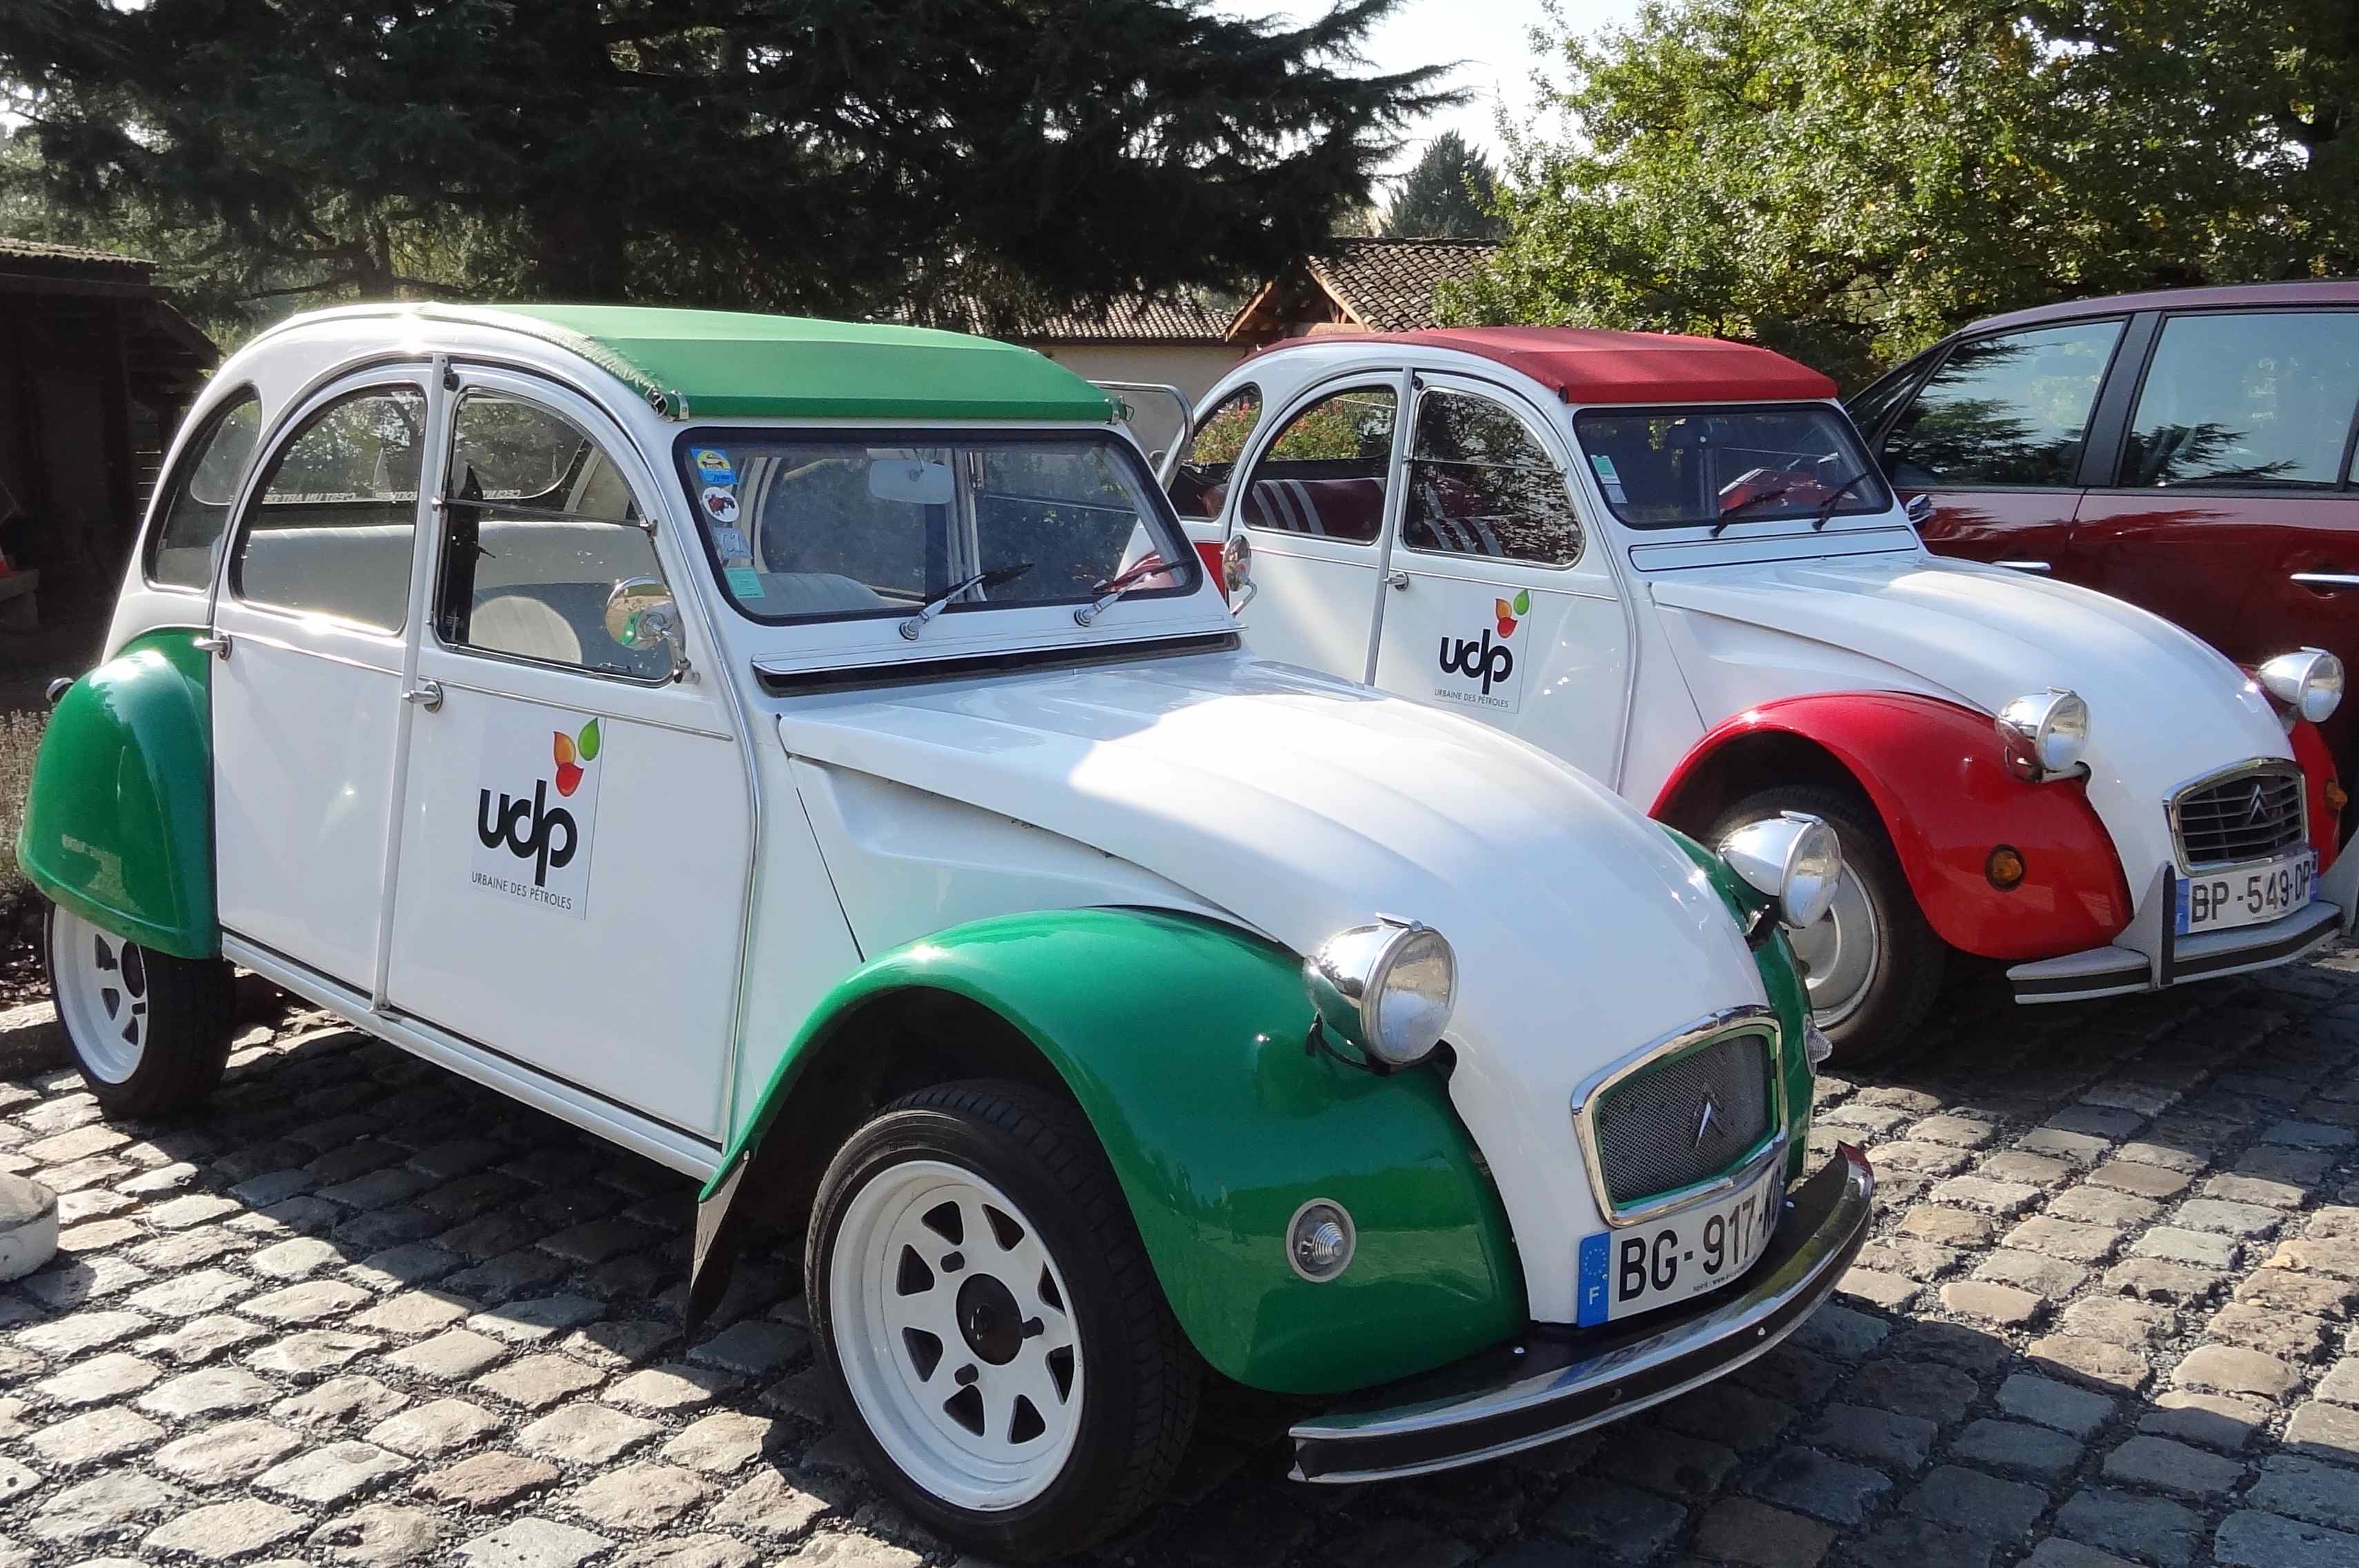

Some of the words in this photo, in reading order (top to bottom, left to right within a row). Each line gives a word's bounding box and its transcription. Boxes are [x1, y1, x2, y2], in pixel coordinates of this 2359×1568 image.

[1440, 628, 1513, 695] udp
[1435, 688, 1462, 700] URBAINE
[1463, 693, 1476, 702] DES
[478, 778, 578, 887] udp
[471, 871, 509, 892] URBAINE
[511, 882, 527, 897] DES
[530, 886, 572, 910] PÉTROLES
[1589, 1286, 1600, 1304] F
